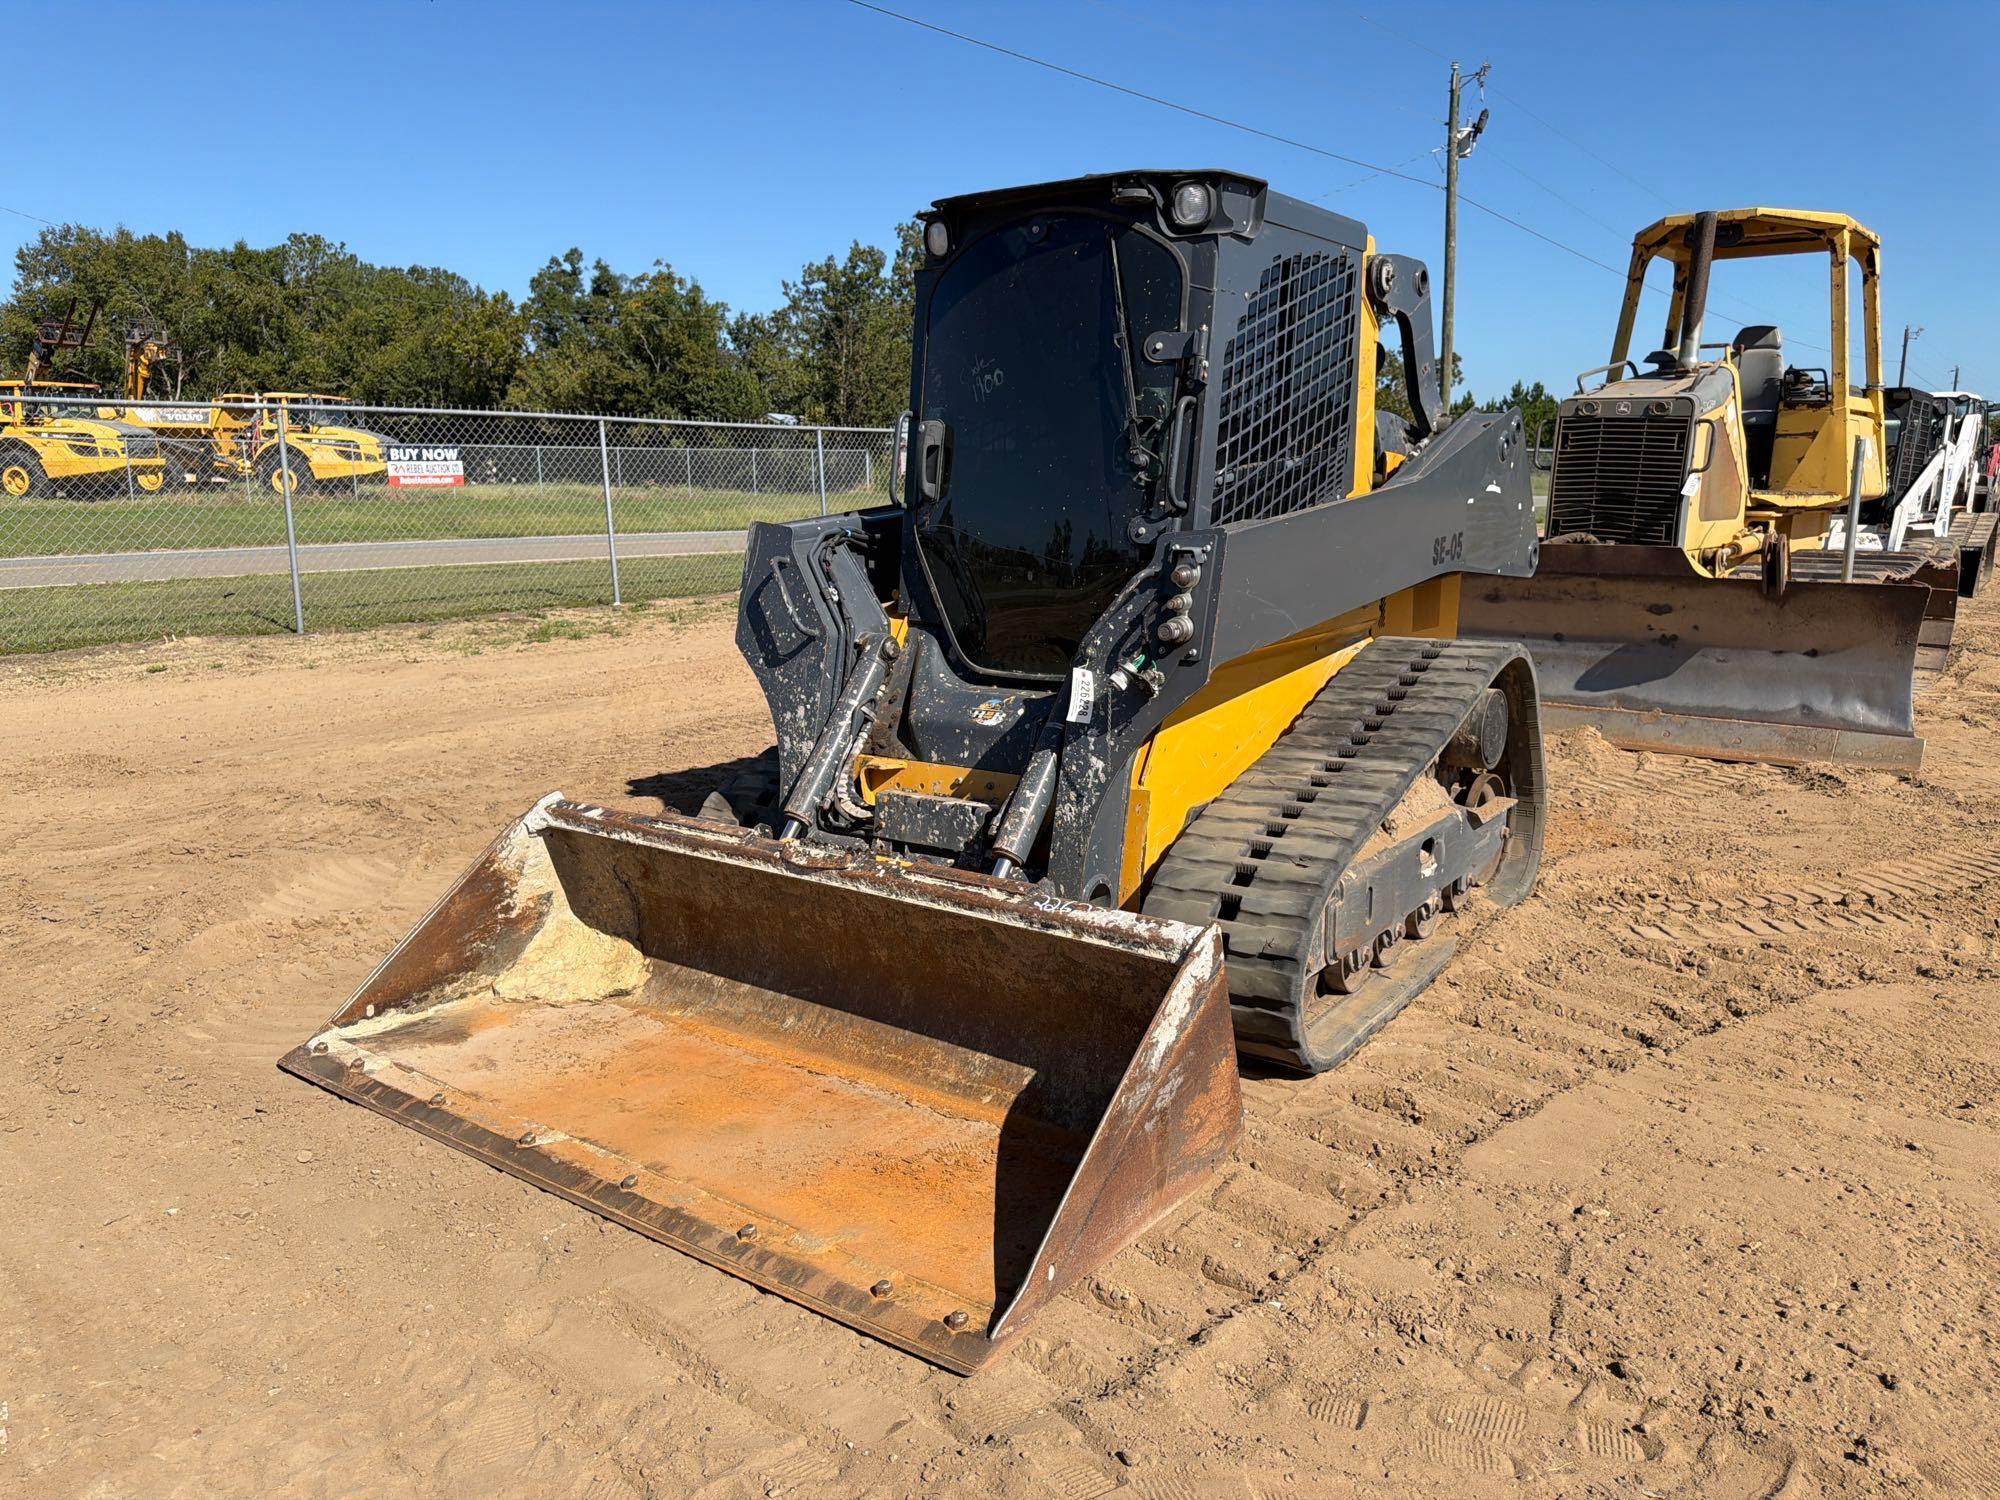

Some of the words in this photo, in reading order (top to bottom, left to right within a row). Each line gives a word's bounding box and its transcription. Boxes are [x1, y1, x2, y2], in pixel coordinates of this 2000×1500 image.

[166, 413, 204, 422] VOLVO
[390, 448, 418, 461] BUY
[421, 448, 458, 461] NOW
[1077, 680, 1091, 717] 226228
